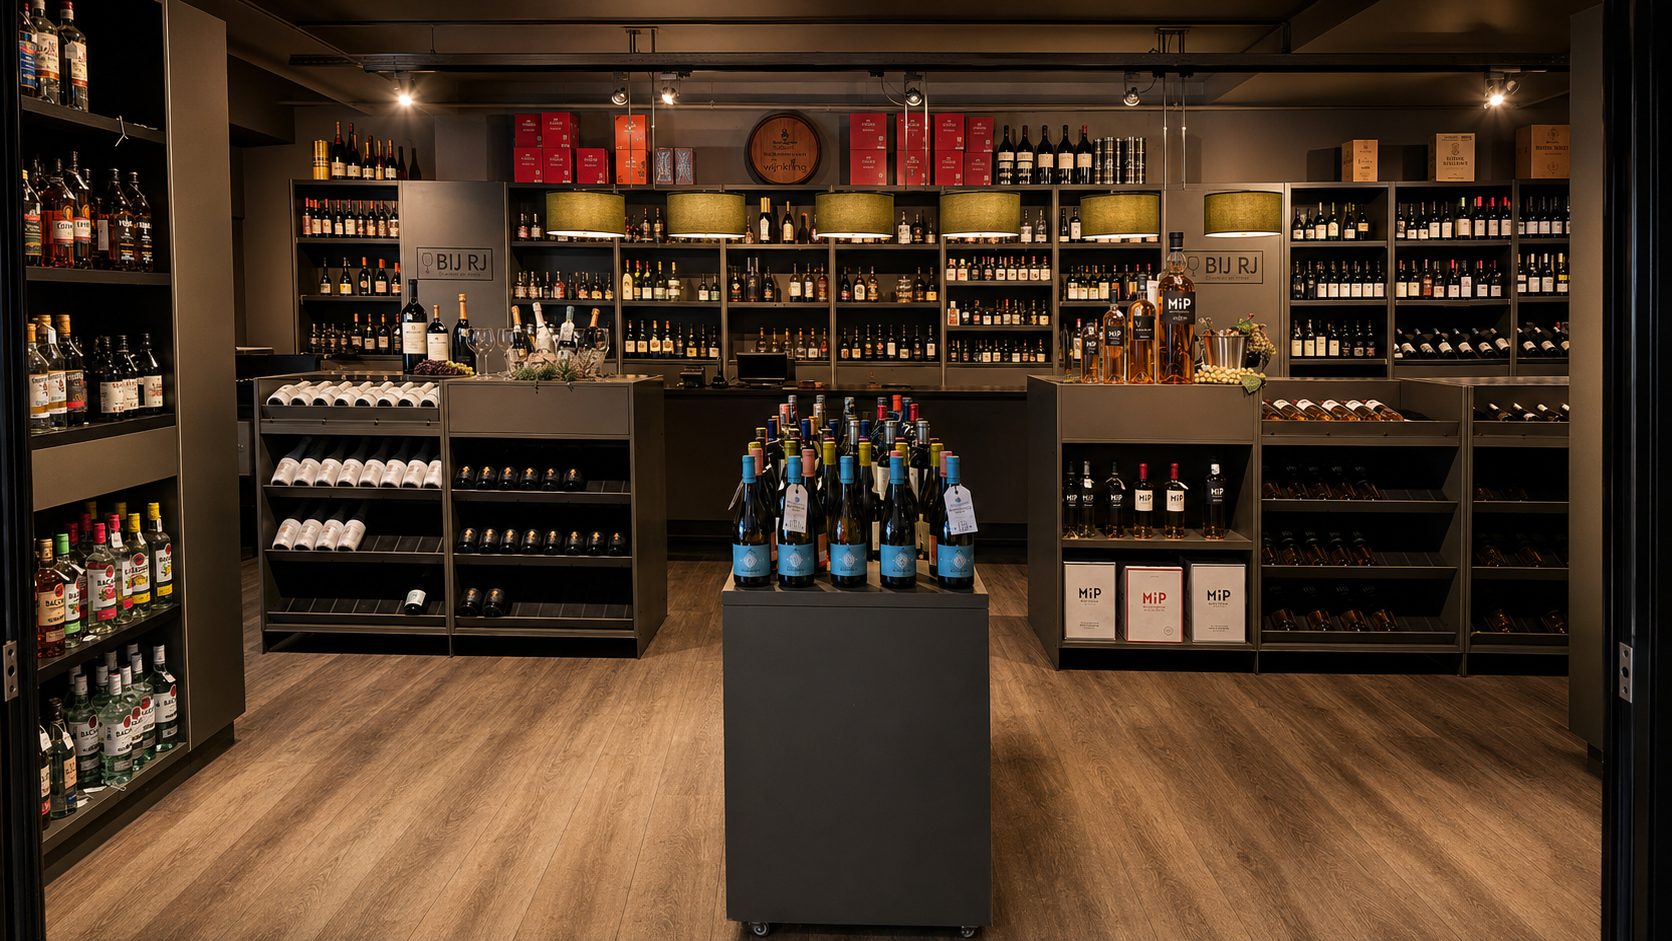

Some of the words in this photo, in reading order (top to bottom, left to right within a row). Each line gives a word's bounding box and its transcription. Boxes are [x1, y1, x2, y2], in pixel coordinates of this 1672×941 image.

[436, 253, 461, 271] BIJ
[467, 254, 487, 271] RJ
[1205, 256, 1231, 274] BIJ
[1238, 256, 1257, 275] RJ
[1168, 297, 1191, 310] MiP
[1078, 587, 1102, 599] MiP
[1142, 592, 1167, 604] MiP
[1206, 589, 1231, 601] MiP
